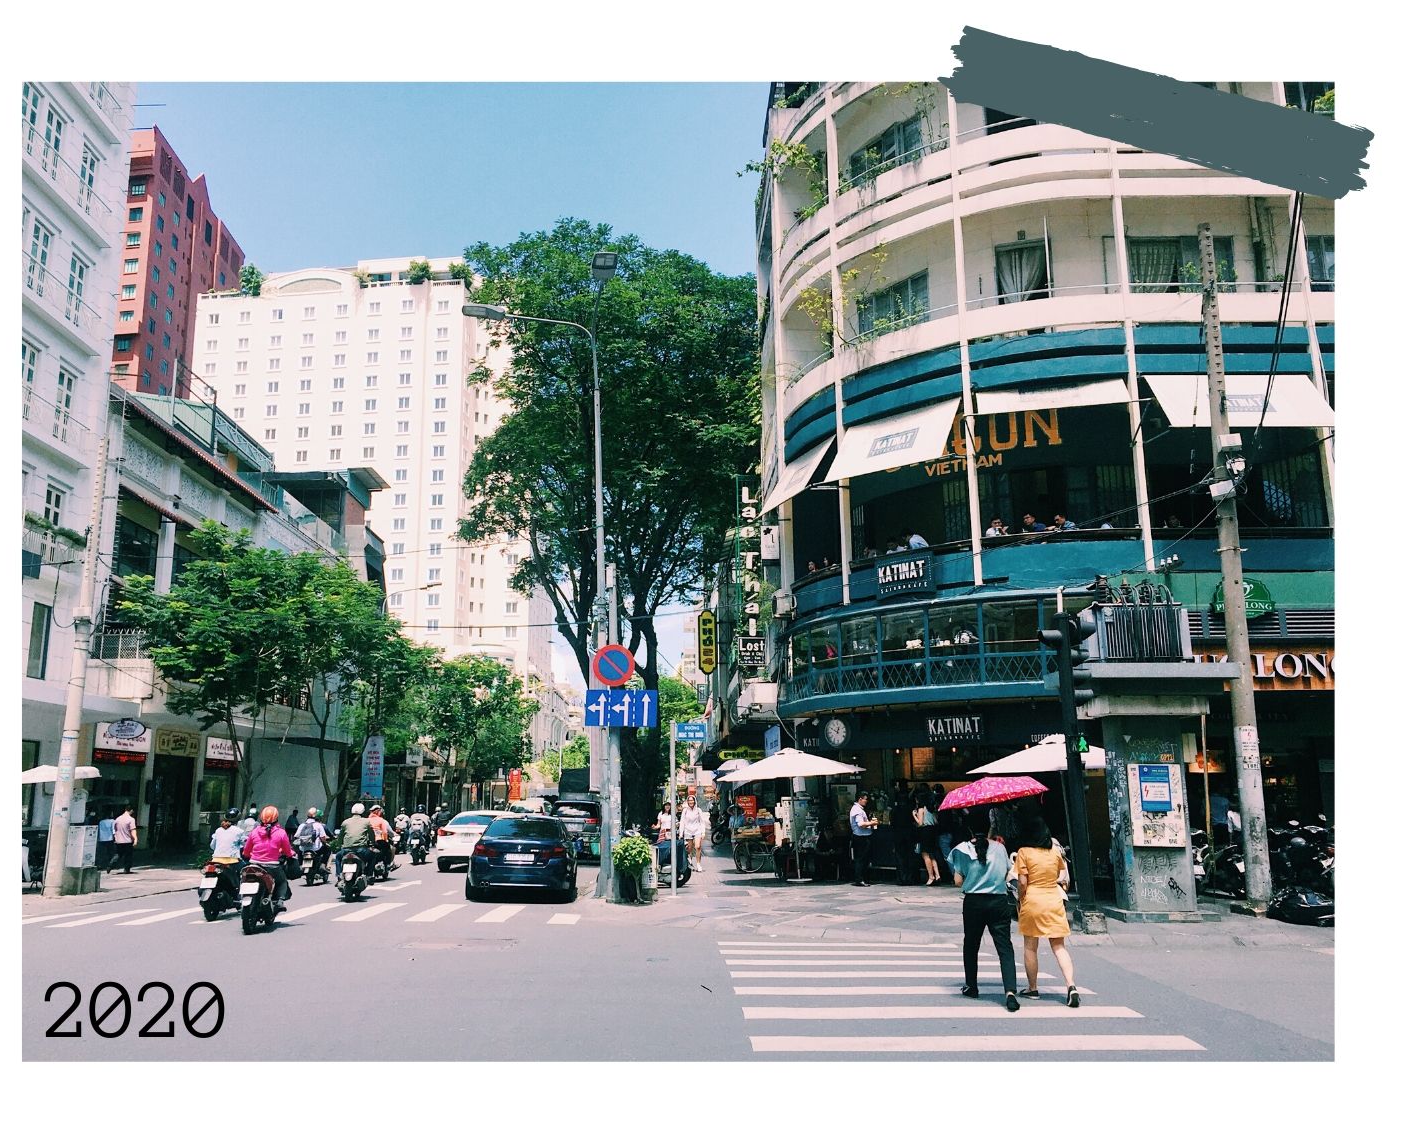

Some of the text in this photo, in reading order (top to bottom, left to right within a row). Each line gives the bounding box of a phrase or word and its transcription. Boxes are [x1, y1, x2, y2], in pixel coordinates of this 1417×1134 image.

[874, 432, 914, 450] KATINAT
[878, 559, 925, 584] KATINAT
[1245, 601, 1272, 610] LONG
[739, 638, 764, 652] Lost
[1252, 653, 1334, 678] LON
[928, 716, 980, 735] KATINAT
